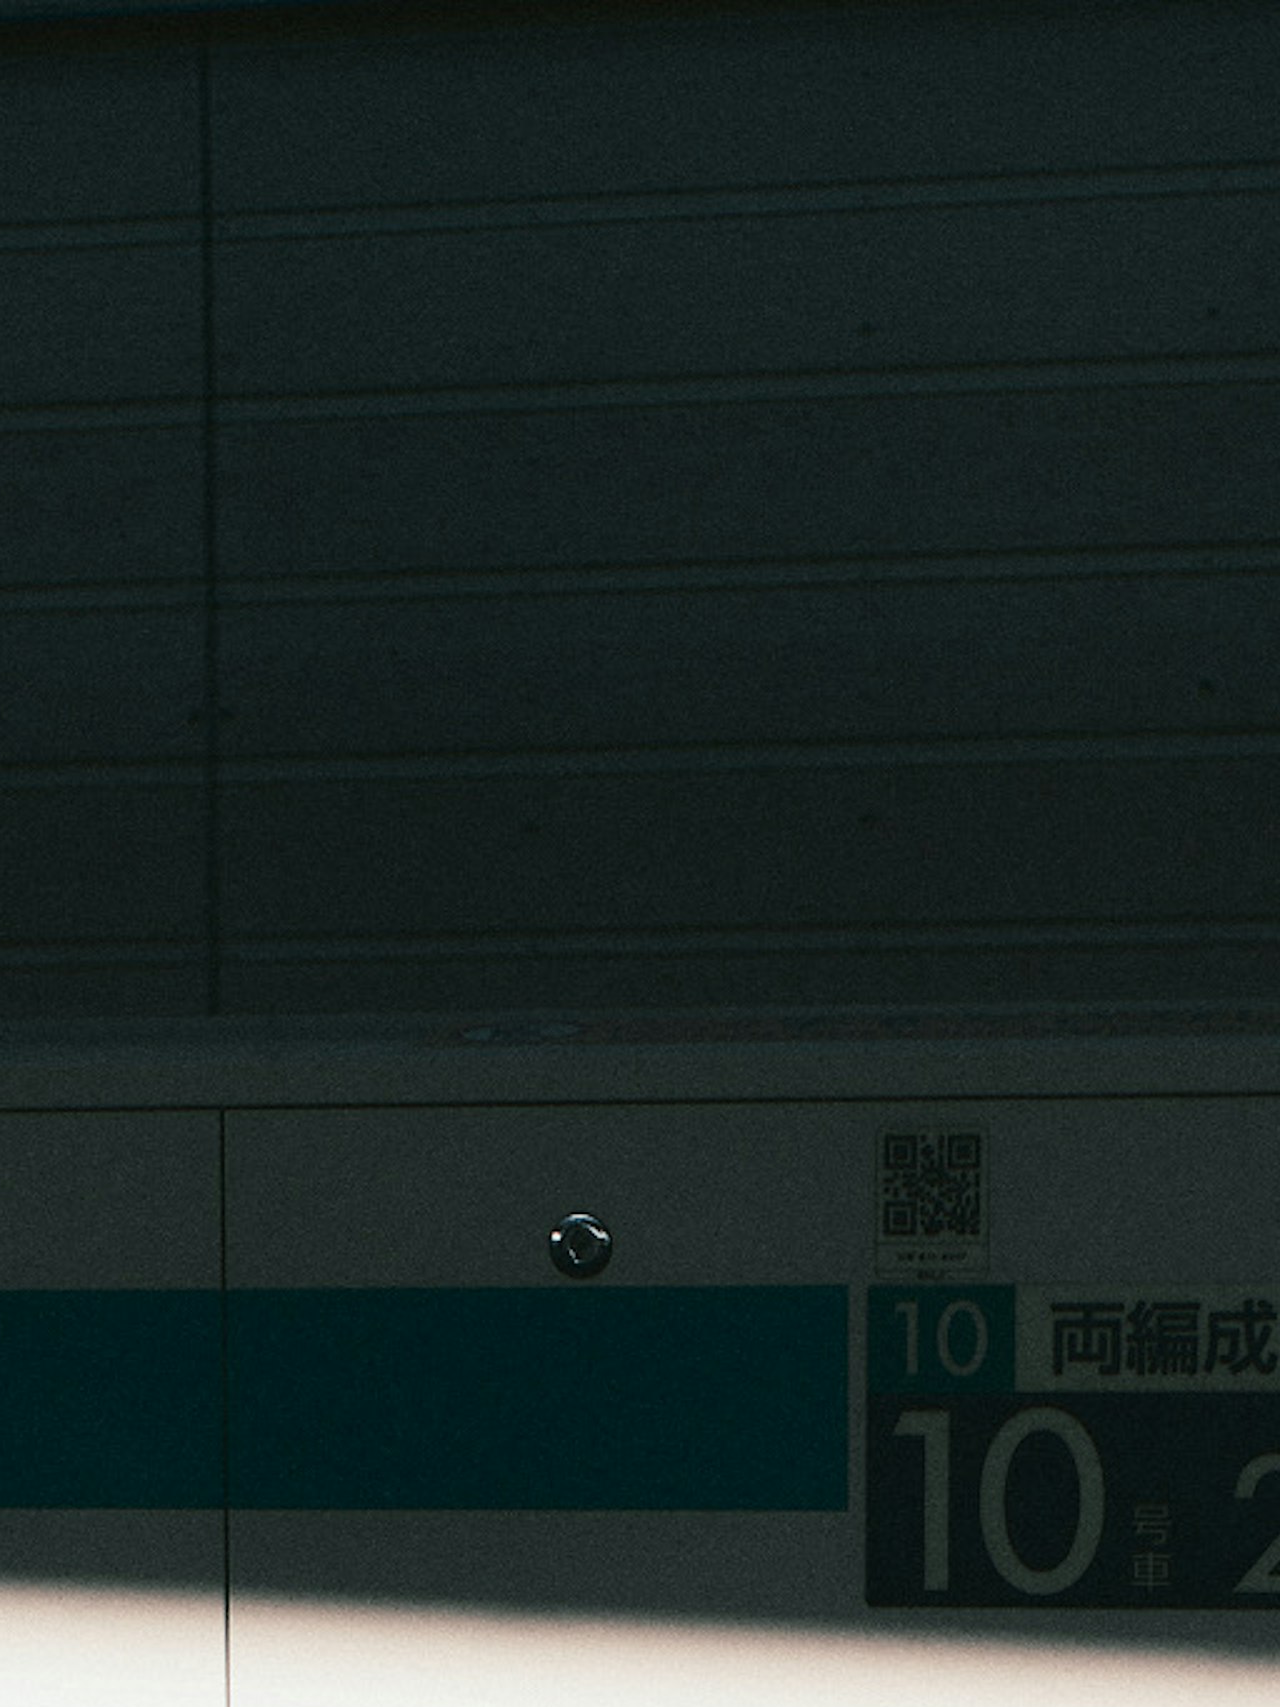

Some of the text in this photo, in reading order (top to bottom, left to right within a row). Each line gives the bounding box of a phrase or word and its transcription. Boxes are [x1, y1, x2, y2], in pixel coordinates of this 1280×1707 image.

[893, 1299, 989, 1378] 10
[1047, 1299, 1279, 1377] 両編成
[893, 1405, 1106, 1596] 10
[1131, 1502, 1172, 1592] 号車
